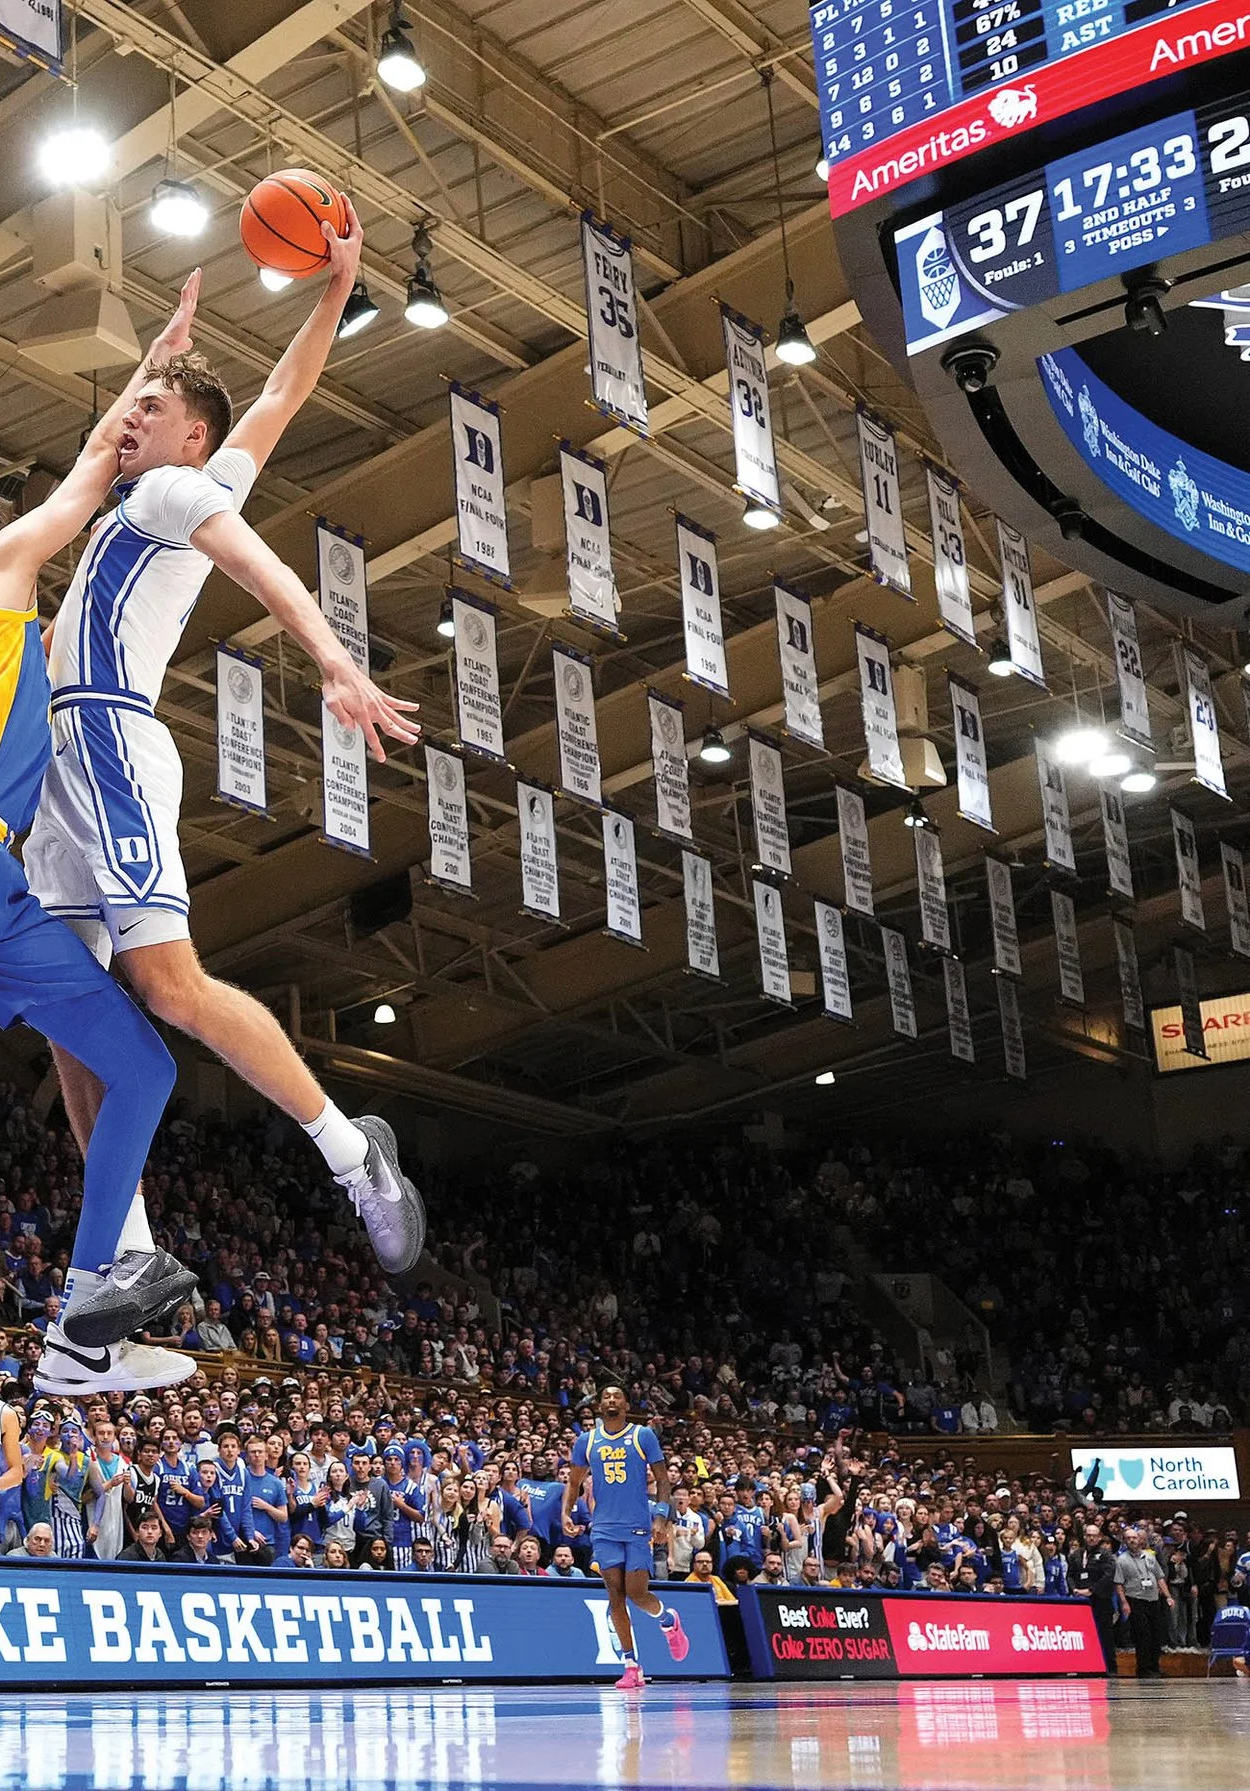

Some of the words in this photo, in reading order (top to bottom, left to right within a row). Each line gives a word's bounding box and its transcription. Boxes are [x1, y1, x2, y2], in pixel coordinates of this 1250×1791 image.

[814, 4, 839, 28] PL
[823, 33, 835, 50] 2
[851, 16, 863, 34] 7
[880, 1, 892, 18] 5
[976, 5, 1021, 34] 67%
[825, 58, 837, 76] 5
[854, 43, 866, 60] 3
[883, 27, 895, 44] 1
[914, 12, 926, 29] 1
[987, 29, 1017, 56] 24
[1061, 15, 1113, 51] AST
[1150, 15, 1250, 71] Amer
[828, 84, 840, 101] 7
[852, 66, 874, 90] 12
[886, 53, 898, 71] 0
[917, 37, 930, 55] 2
[989, 54, 1019, 81] 10
[830, 110, 843, 129] 9
[859, 95, 872, 114] 6
[888, 79, 901, 98] 5
[920, 64, 933, 83] 2
[828, 134, 851, 158] 14
[862, 122, 874, 140] 3
[892, 106, 904, 125] 6
[923, 92, 936, 110] 1
[850, 119, 987, 200] Ameritas
[1054, 134, 1197, 222] 17:33
[1083, 207, 1119, 230] 2ND
[1123, 187, 1172, 216] HALF
[967, 189, 1045, 264] 37
[1065, 240, 1075, 254] 3
[1083, 203, 1176, 247] TIMEOUTS
[1183, 196, 1196, 211] 3
[1108, 229, 1154, 255] POSS
[983, 257, 1032, 288] Fouls:
[1034, 251, 1044, 266] 1
[599, 286, 634, 339] 35
[737, 379, 766, 429] 32
[1141, 454, 1162, 480] Duke
[471, 483, 493, 504] NCAA
[873, 474, 893, 515] 11
[460, 499, 484, 521] FINAL
[1208, 513, 1225, 535] Inn
[1226, 521, 1236, 539] &
[939, 523, 964, 566] 33
[1011, 571, 1030, 610] 31
[695, 607, 713, 624] NCAA
[464, 657, 492, 678] ATLANTIC
[469, 672, 489, 688] COAST
[460, 681, 499, 705] CONFERENCE
[463, 695, 500, 719] CHAMPIONS
[564, 707, 590, 726] ATLANTIC
[226, 712, 257, 731] ATLANTIC
[231, 726, 252, 742] COAST
[220, 735, 262, 760] CONFERENCE
[222, 749, 262, 772] CHAMPIONS
[332, 756, 359, 774] ATLANTIC
[337, 770, 356, 786] COAST
[326, 779, 366, 802] CONFERENCE
[328, 792, 365, 815] CHAMPIONS
[116, 835, 150, 864] D
[1162, 1011, 1250, 1038] SAR
[598, 1446, 627, 1461] Pitt
[1150, 1457, 1203, 1472] North
[604, 1462, 627, 1485] 55
[1153, 1474, 1230, 1490] Carolina
[229, 1496, 235, 1513] 1
[83, 1589, 493, 1662] BASKETBALL
[778, 1605, 811, 1628] Best
[809, 1605, 837, 1629] Coke
[835, 1606, 870, 1629] Ever?
[772, 1633, 805, 1659] Coke
[806, 1637, 843, 1660] ZERO
[846, 1637, 890, 1660] SUGAR
